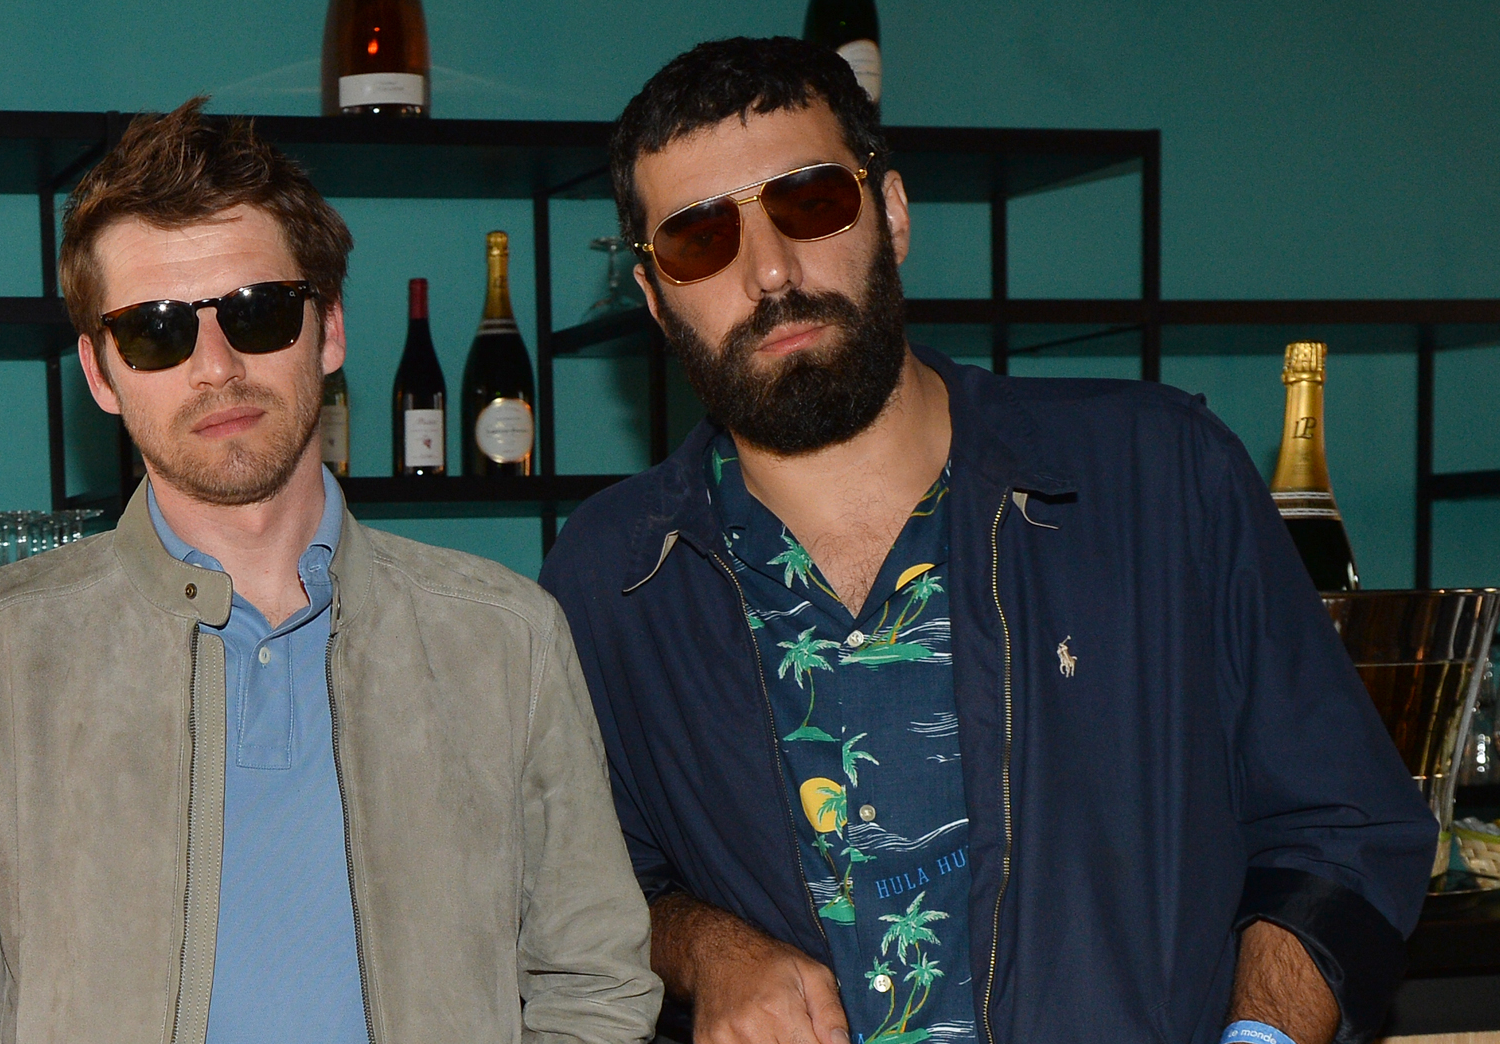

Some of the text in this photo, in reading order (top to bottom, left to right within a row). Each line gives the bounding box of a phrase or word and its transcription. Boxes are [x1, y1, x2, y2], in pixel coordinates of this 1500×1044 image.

[875, 844, 969, 899] HULA HU
[1241, 1029, 1277, 1044] monde
